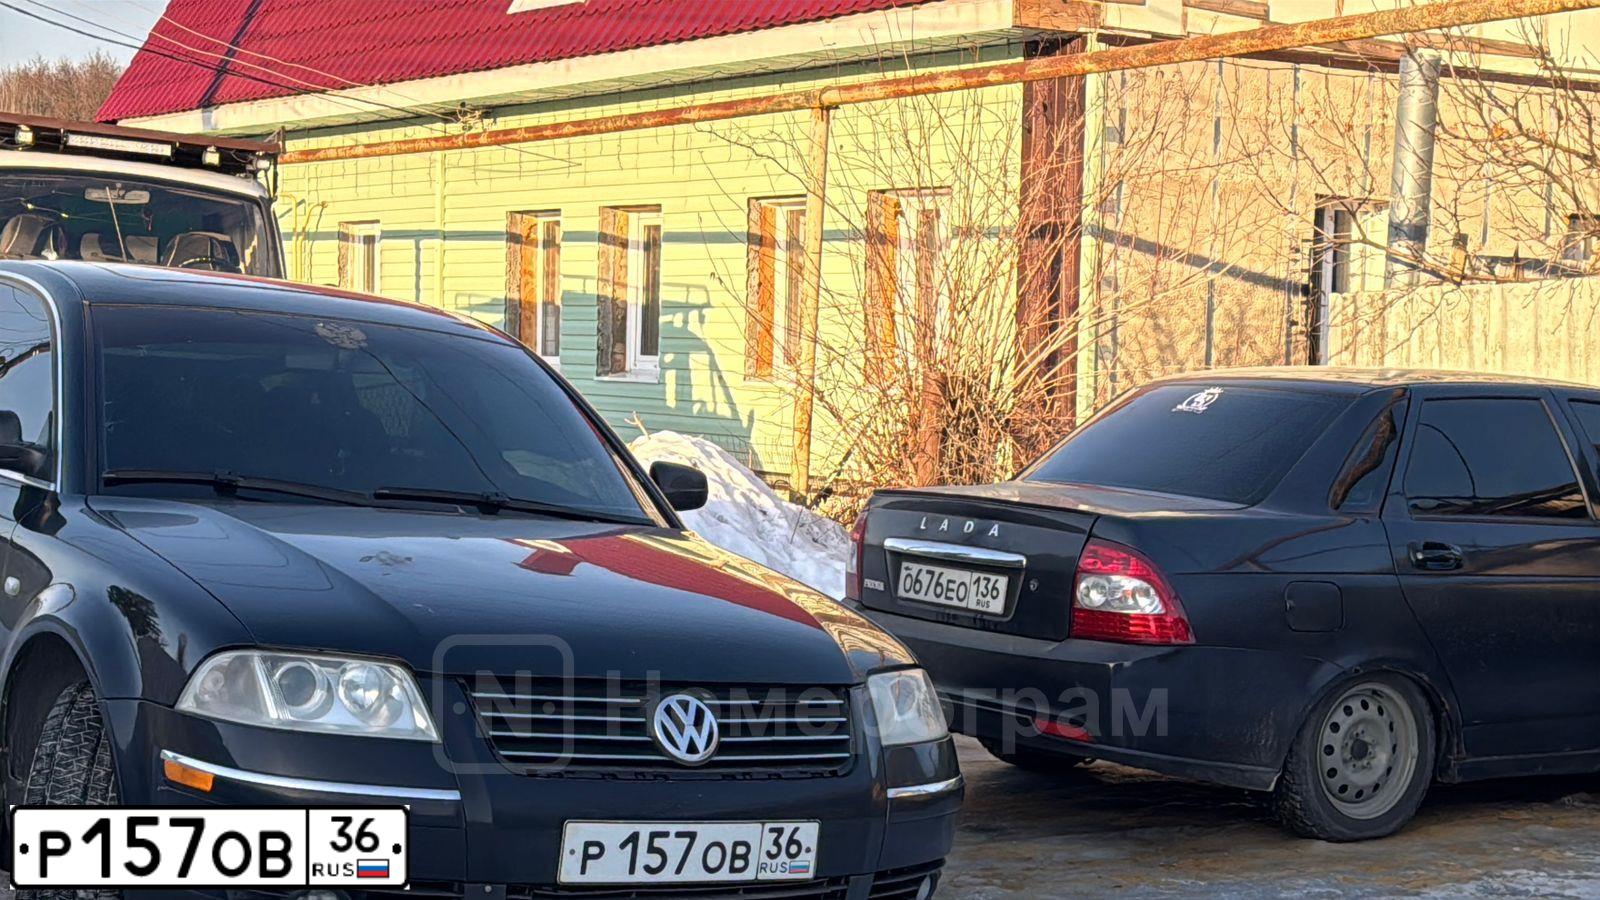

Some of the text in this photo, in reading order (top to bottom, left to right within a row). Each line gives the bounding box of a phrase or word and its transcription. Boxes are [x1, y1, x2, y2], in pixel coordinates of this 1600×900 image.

[919, 516, 1000, 537] LADA
[973, 576, 1000, 600] 136
[976, 600, 990, 609] RUS
[765, 826, 803, 860] 36
[759, 861, 788, 874] RUS
